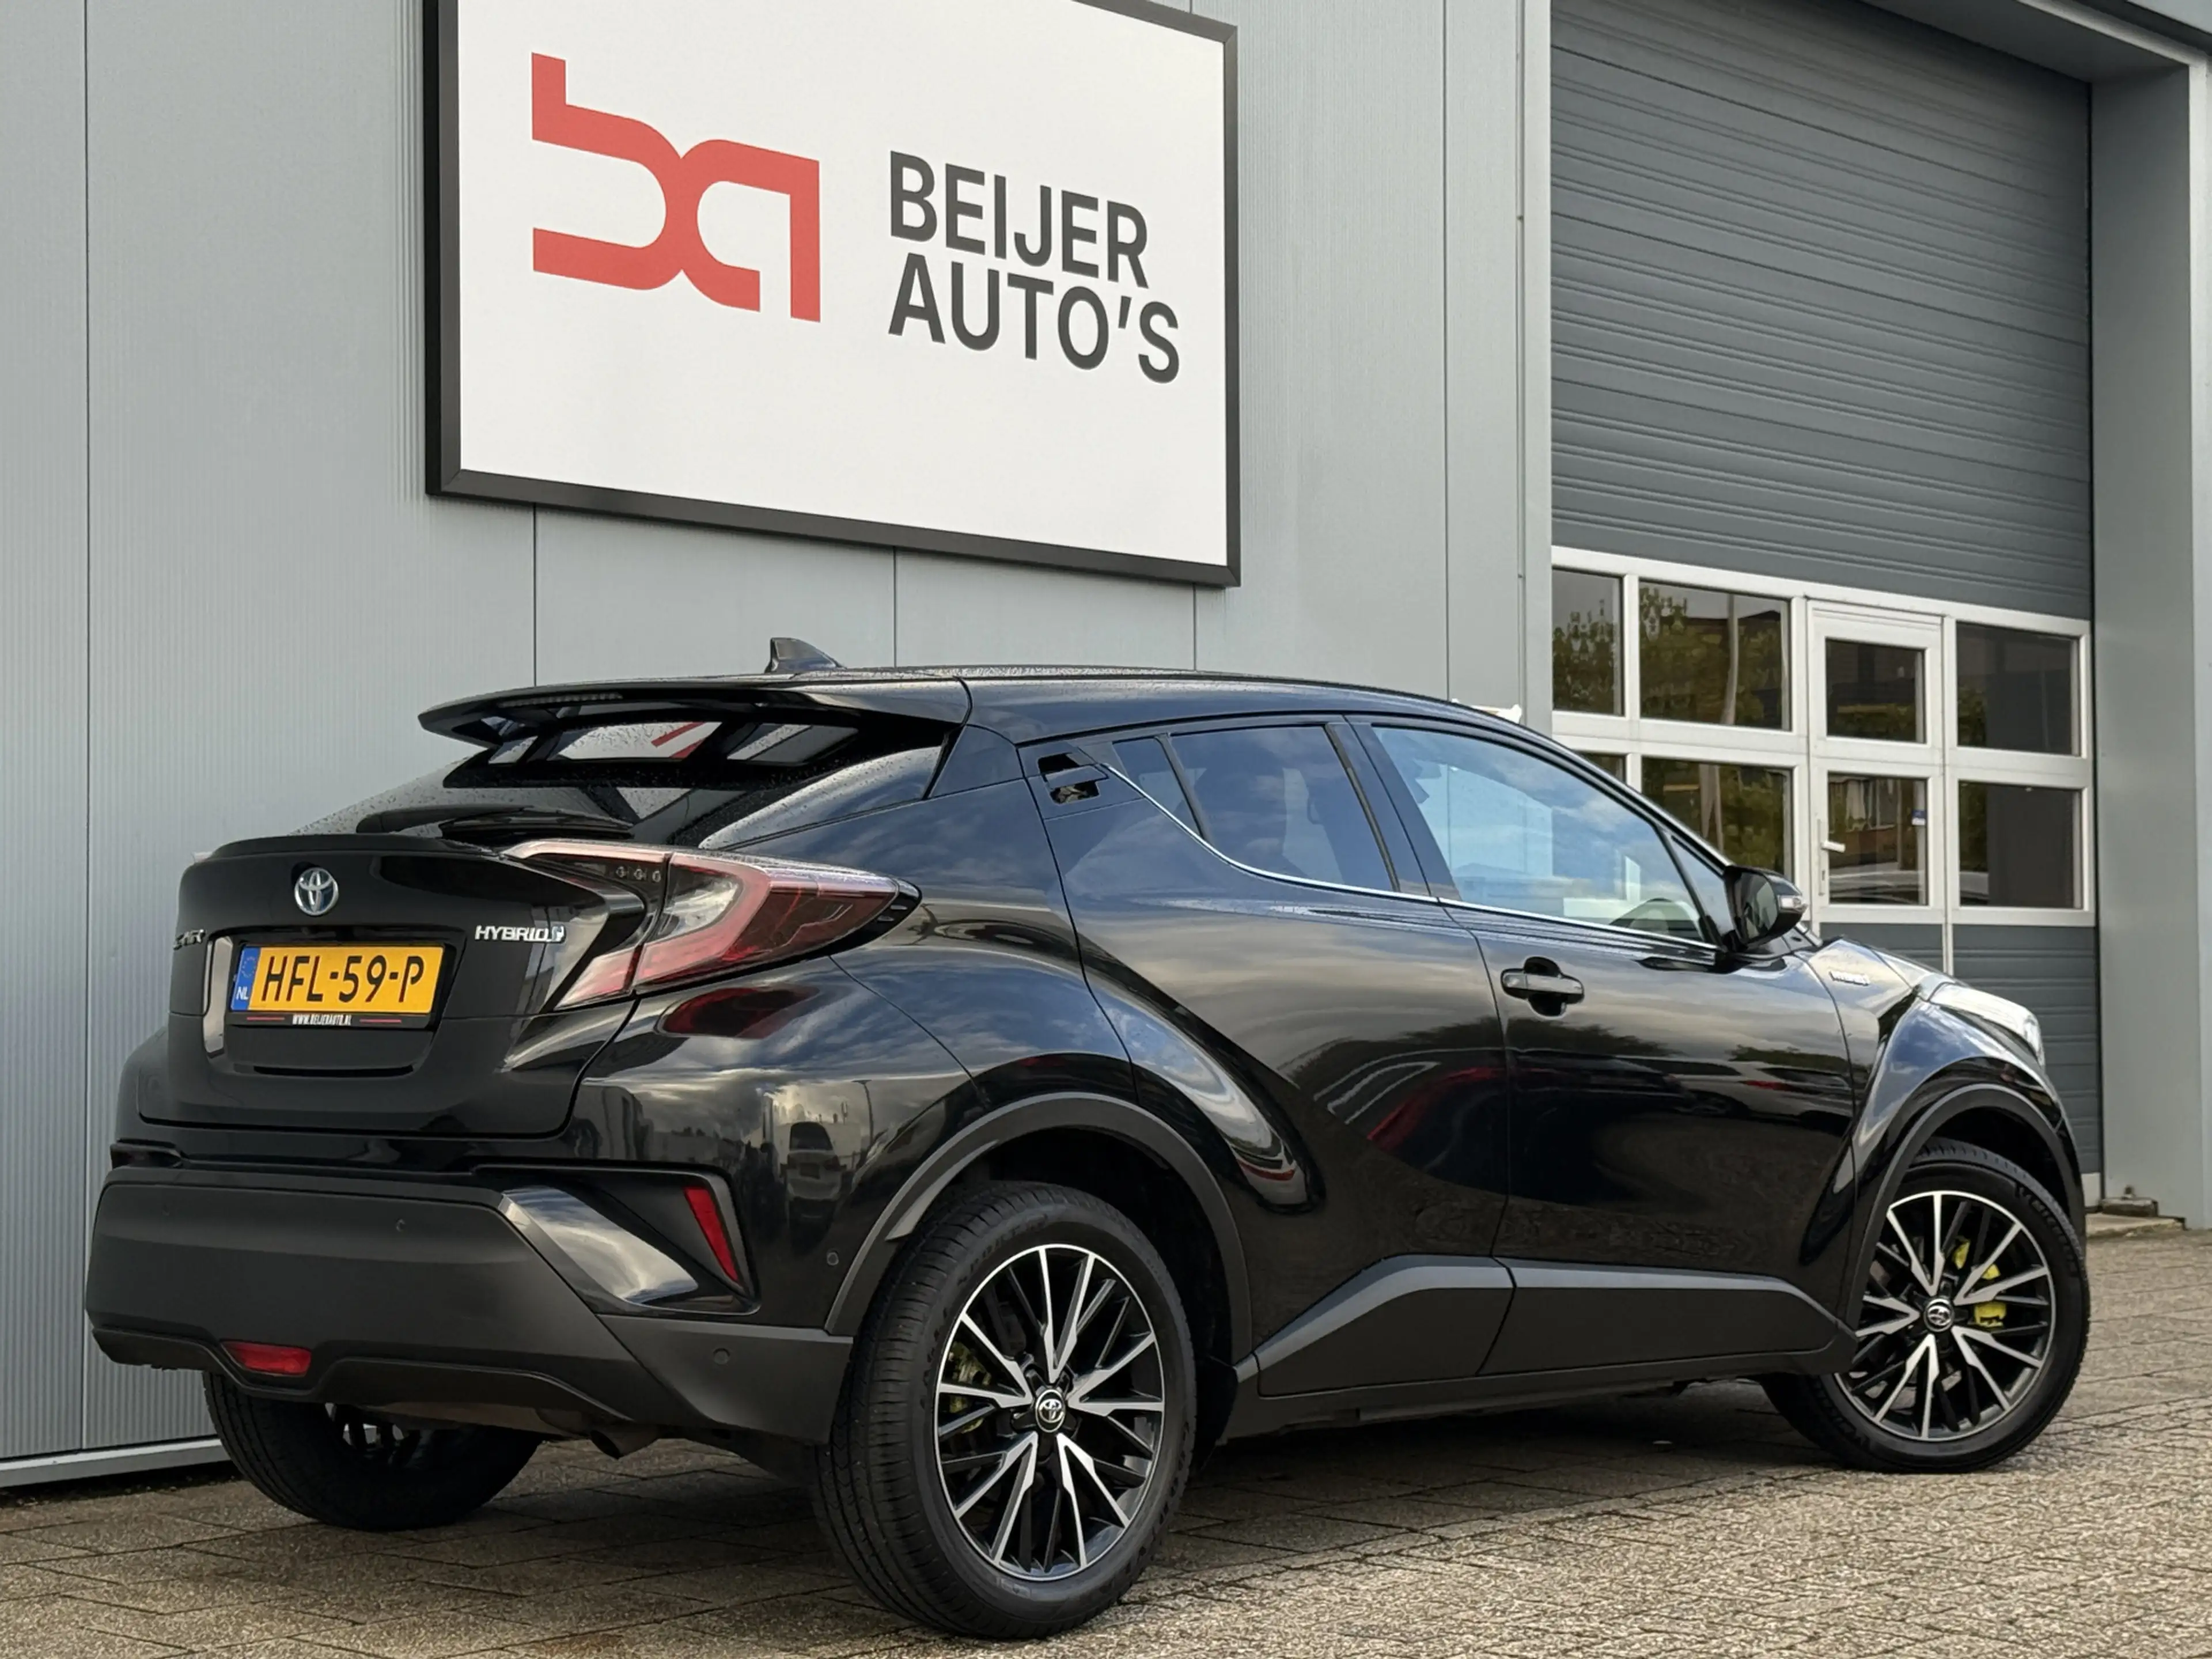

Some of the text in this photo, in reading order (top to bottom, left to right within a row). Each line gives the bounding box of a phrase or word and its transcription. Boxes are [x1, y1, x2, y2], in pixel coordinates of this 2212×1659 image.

[890, 150, 1149, 289] BEIJER
[888, 252, 1179, 384] AUTO'S
[475, 925, 549, 942] HYBRID
[236, 986, 249, 1001] NL
[261, 955, 425, 1003] HFL-59-P
